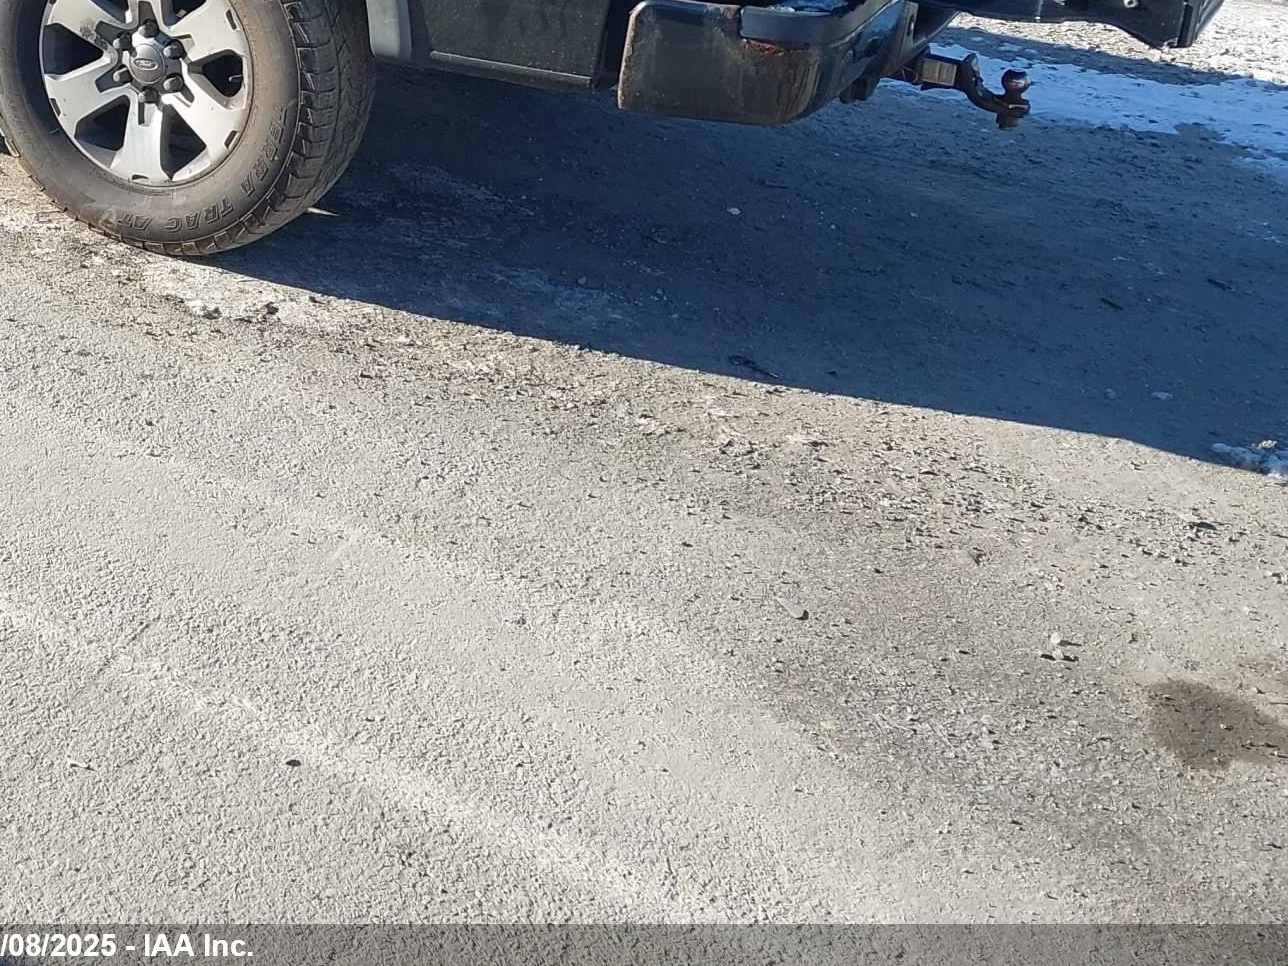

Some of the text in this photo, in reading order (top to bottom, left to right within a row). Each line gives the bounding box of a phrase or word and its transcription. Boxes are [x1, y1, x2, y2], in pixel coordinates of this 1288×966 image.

[118, 106, 288, 232] TERRA TRAC AT
